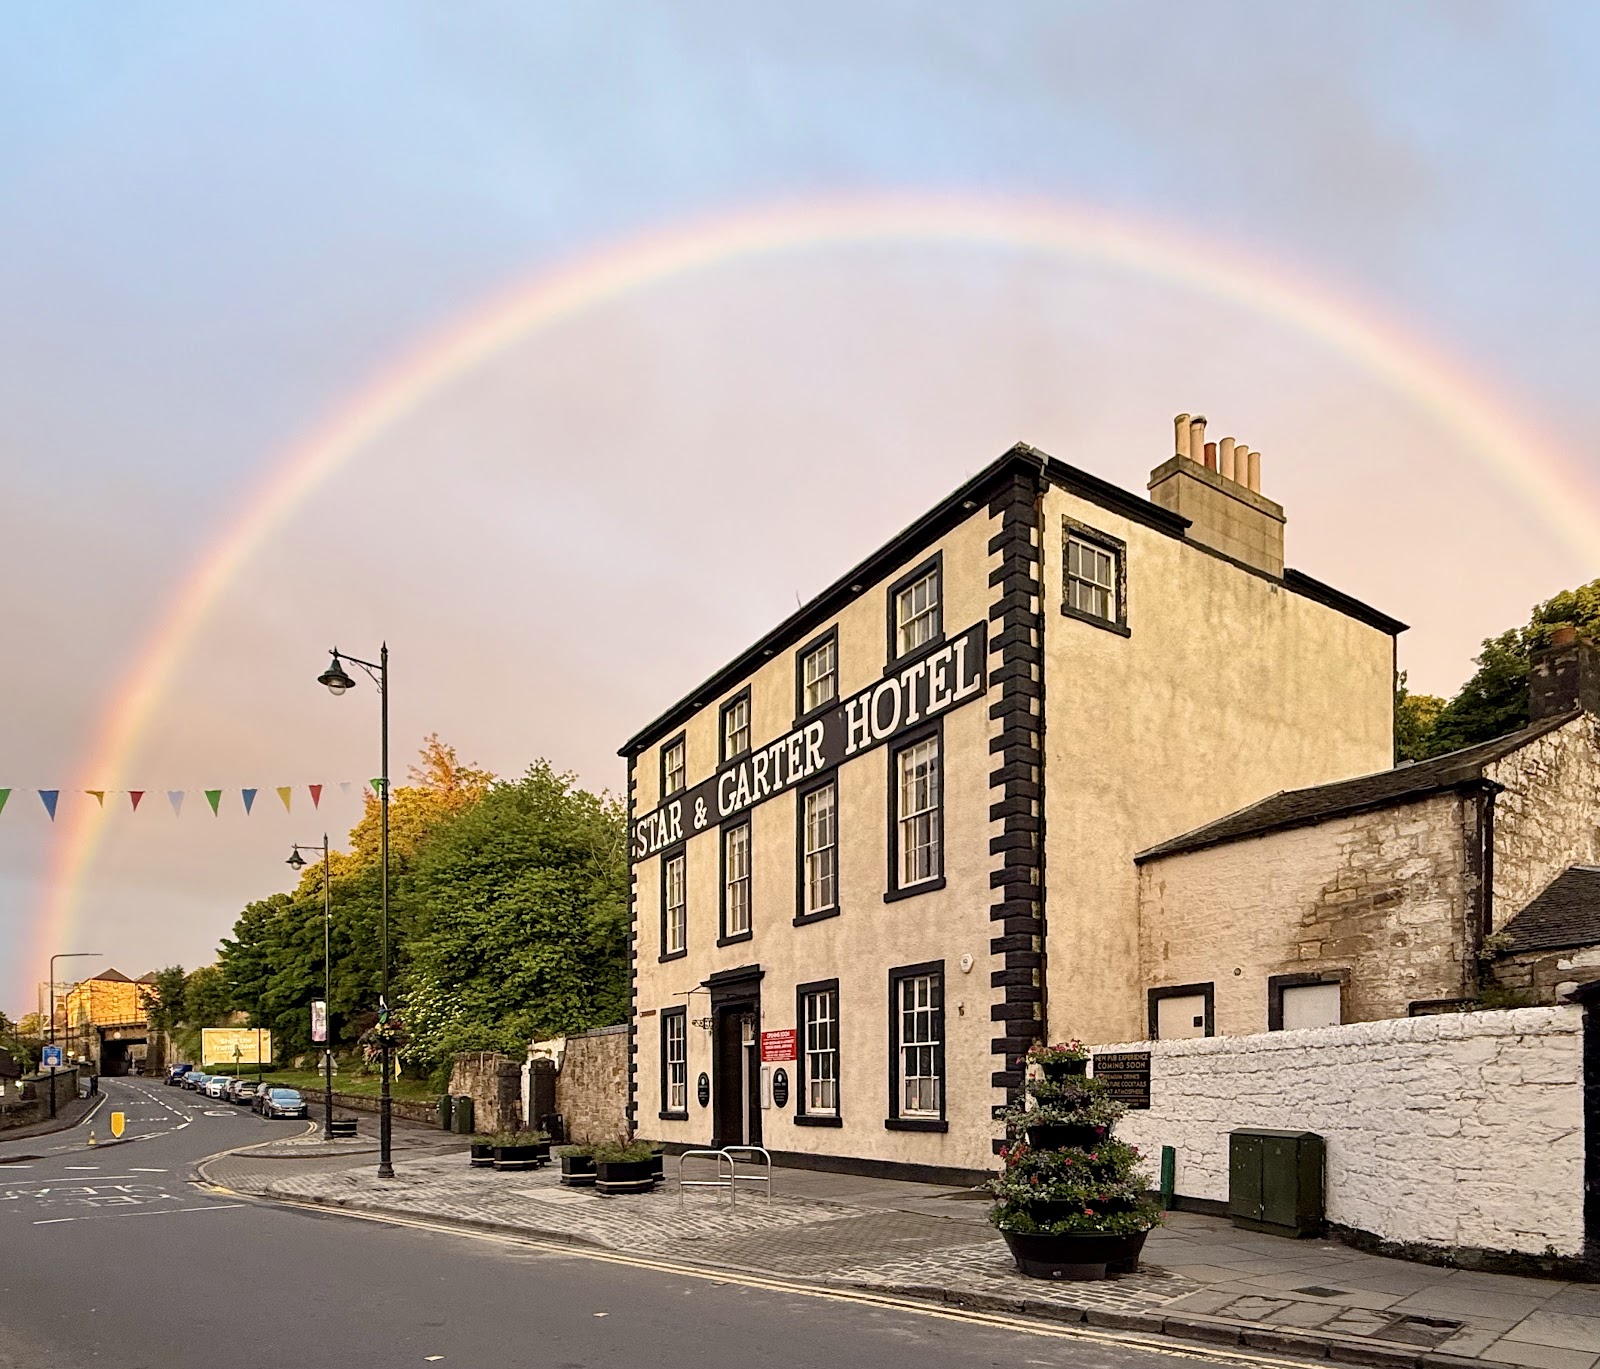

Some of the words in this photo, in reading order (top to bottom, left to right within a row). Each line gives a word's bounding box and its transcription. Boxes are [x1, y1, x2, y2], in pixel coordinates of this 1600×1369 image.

[637, 800, 683, 859] STAR
[694, 796, 708, 830] &
[718, 720, 825, 817] GARTER
[845, 636, 981, 756] HOTEL
[239, 1043, 257, 1051] door
